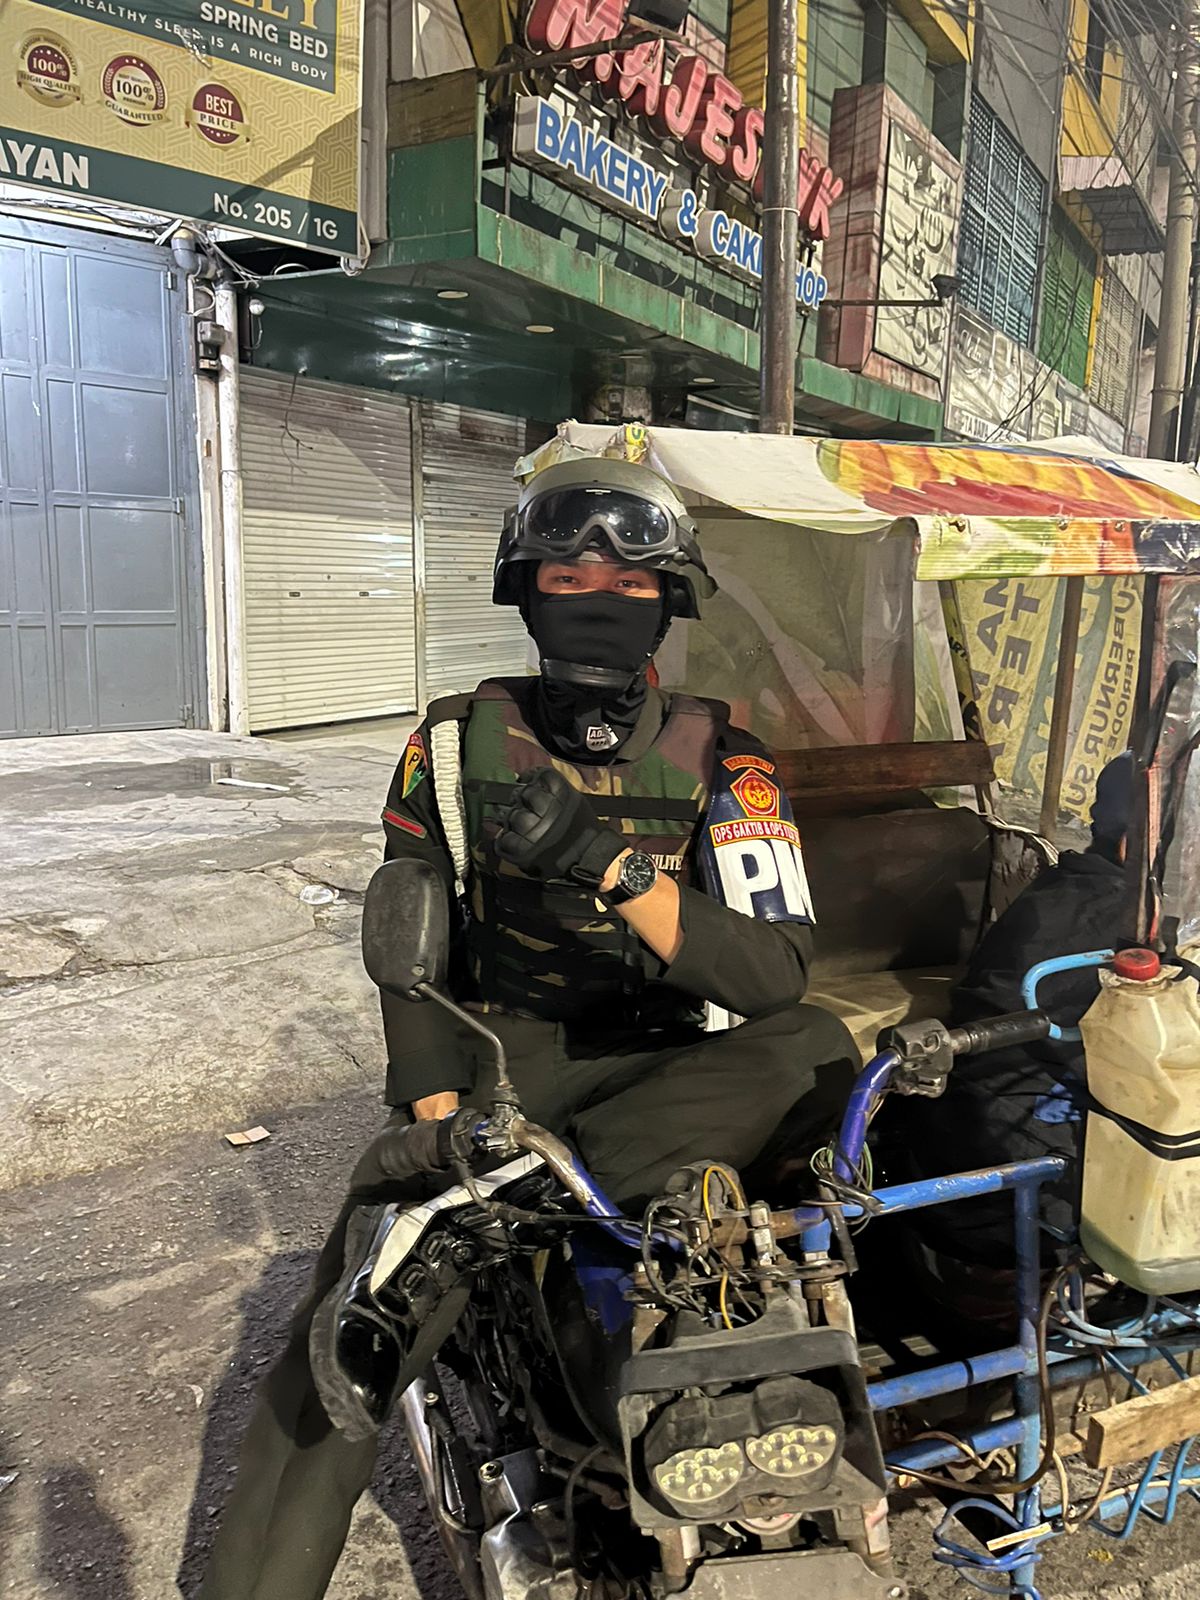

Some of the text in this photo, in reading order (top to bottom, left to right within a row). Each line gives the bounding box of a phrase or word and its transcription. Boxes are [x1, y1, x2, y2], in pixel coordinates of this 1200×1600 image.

[200, 2, 329, 59] SPRING BED
[32, 57, 67, 77] 100%
[211, 35, 224, 48] IS
[230, 42, 240, 54] A
[249, 47, 282, 67] RICH
[291, 61, 327, 81] BODY
[43, 79, 77, 93] QUALITY
[116, 79, 155, 101] 100%
[105, 99, 164, 121] GUARANTEED
[205, 93, 234, 117] BEST
[200, 113, 237, 130] PRICE
[535, 99, 667, 220] BAKERY
[678, 191, 697, 236] &
[213, 192, 338, 240] No. 205 / 1G
[714, 825, 733, 843] OPS
[733, 821, 763, 838] GAKTIB
[770, 821, 784, 836] OPS
